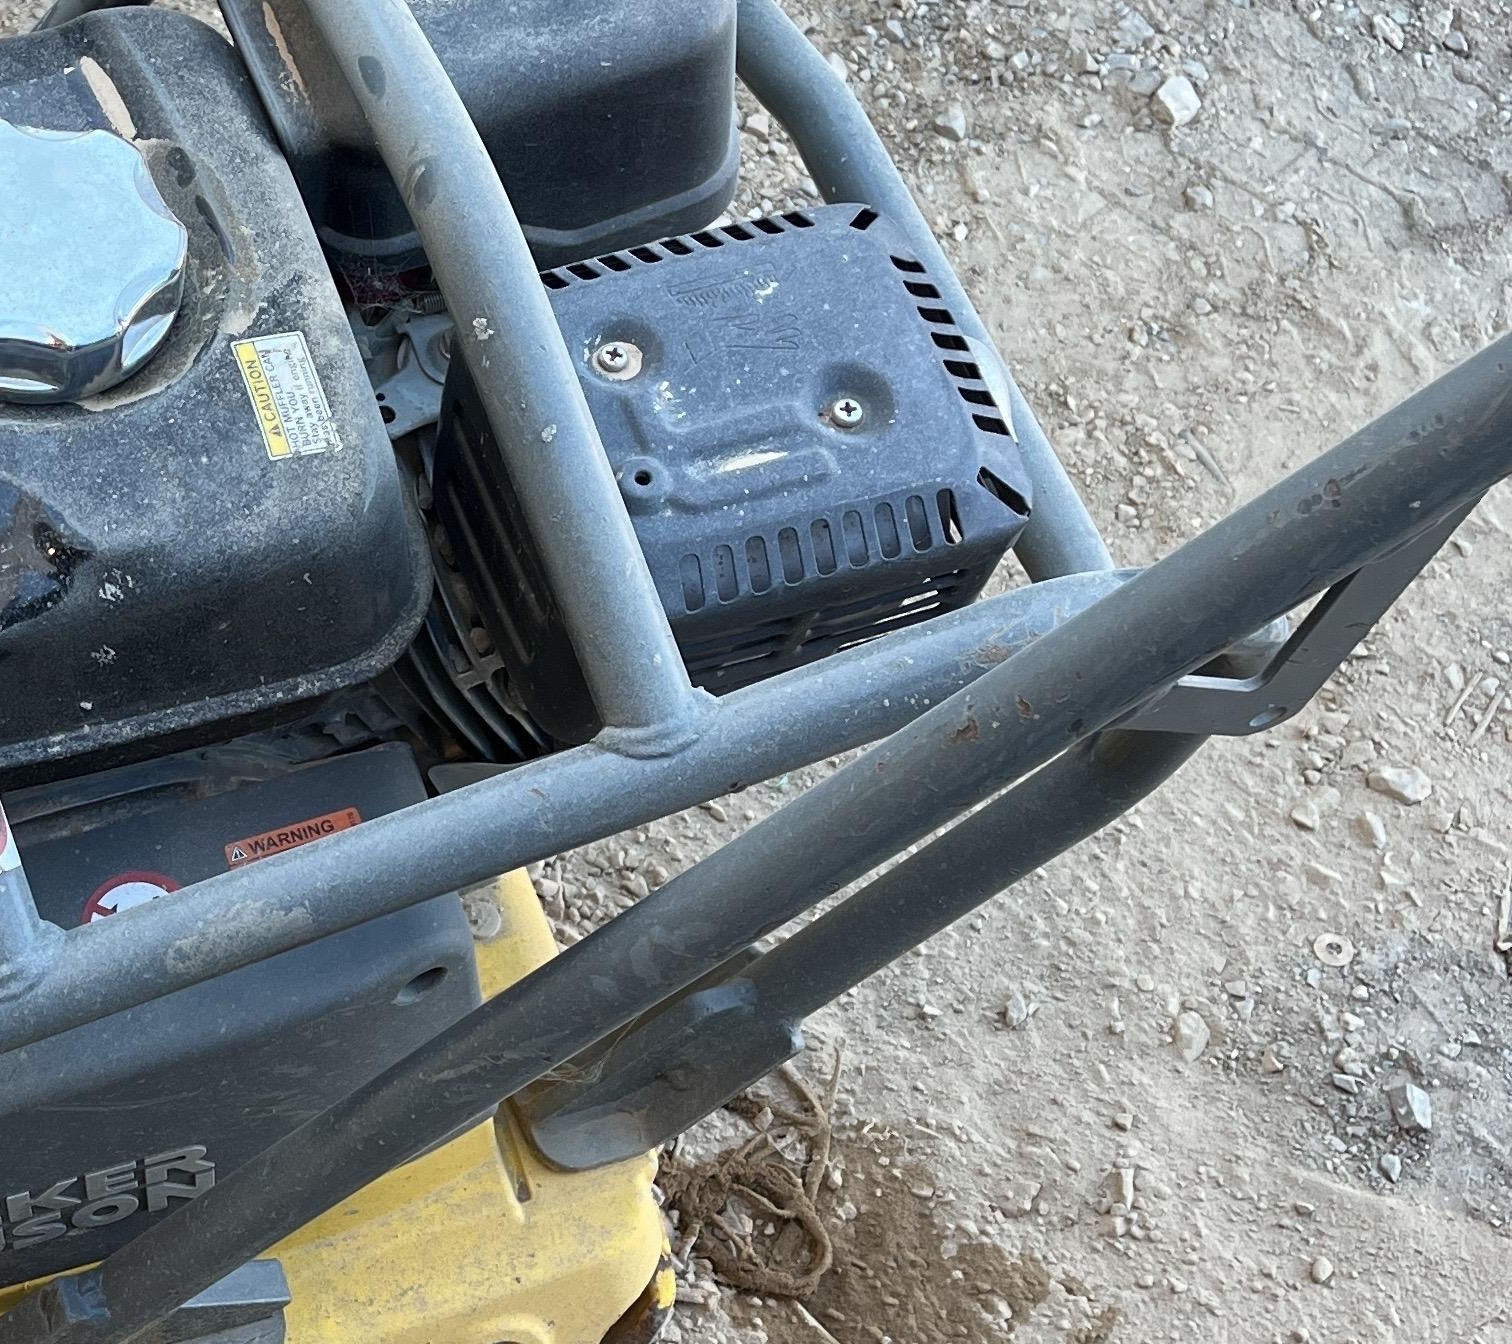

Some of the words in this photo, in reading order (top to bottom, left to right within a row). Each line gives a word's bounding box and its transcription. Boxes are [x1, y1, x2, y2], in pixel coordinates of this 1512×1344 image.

[259, 348, 275, 372] CAN
[245, 359, 277, 423] CAUTION
[269, 374, 292, 424] MUFFLER
[288, 391, 300, 414] YOU
[311, 397, 325, 422] been
[288, 427, 301, 449] HOT
[295, 416, 312, 447] BURN
[309, 421, 322, 445] Stay
[247, 819, 336, 856] WARNING
